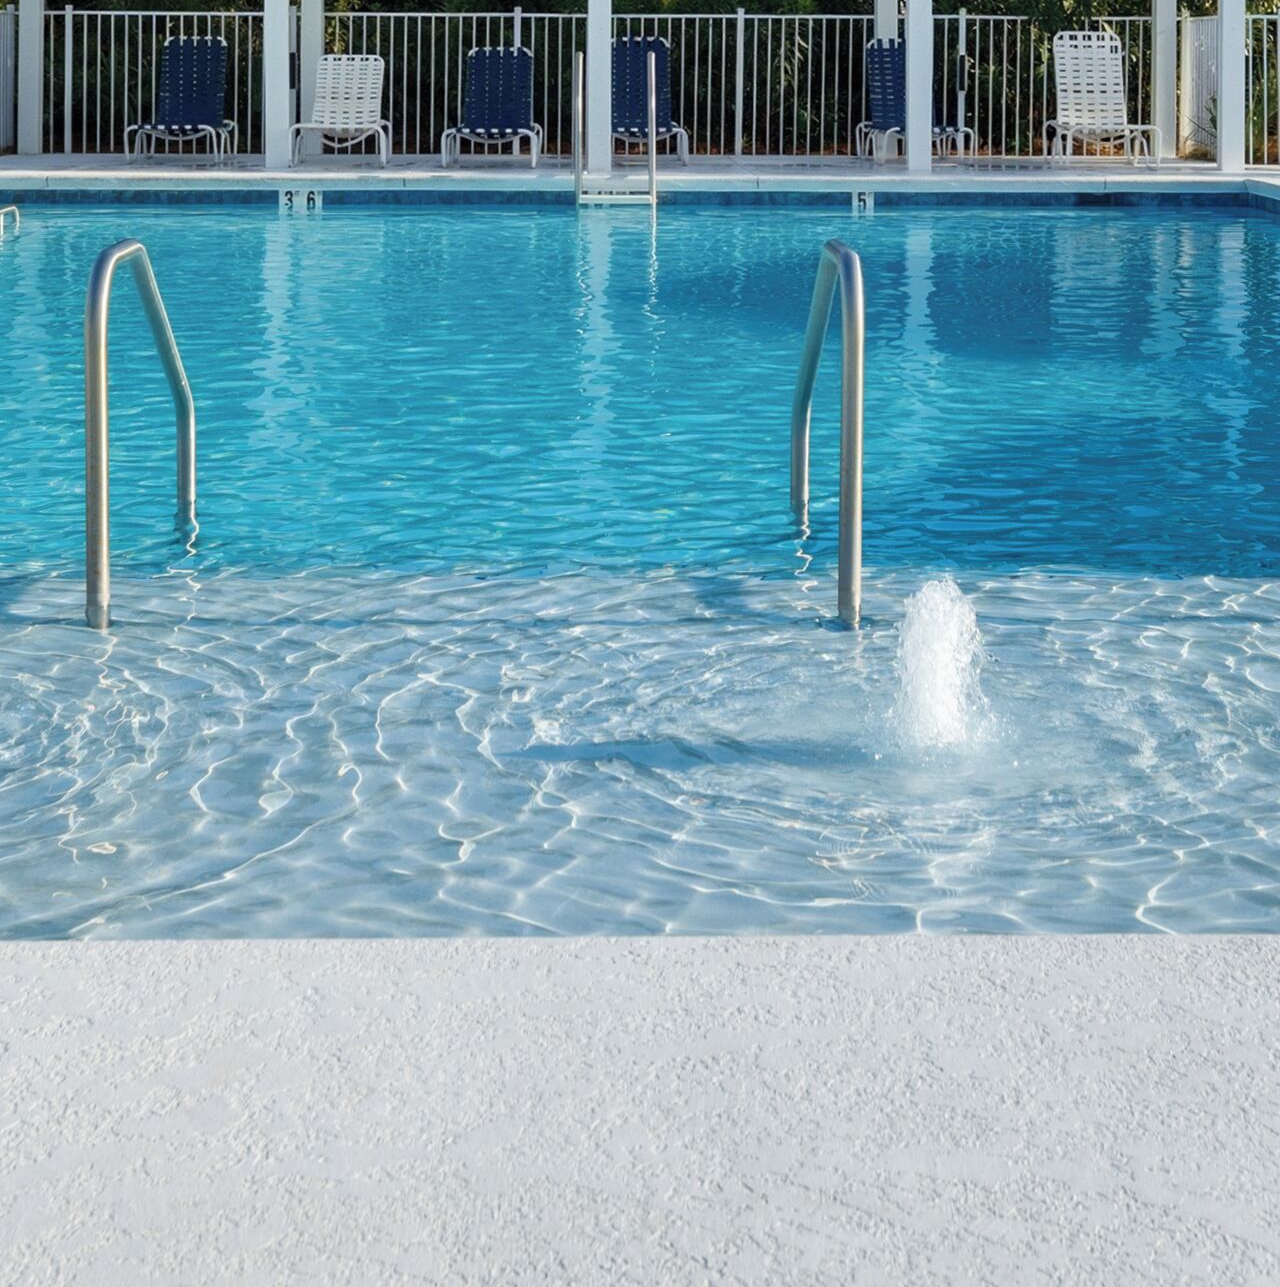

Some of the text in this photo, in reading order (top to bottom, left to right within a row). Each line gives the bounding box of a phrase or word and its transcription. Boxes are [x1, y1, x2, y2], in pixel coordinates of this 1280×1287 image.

[284, 190, 293, 211] 3
[307, 190, 315, 211] 6
[858, 192, 866, 210] 5
